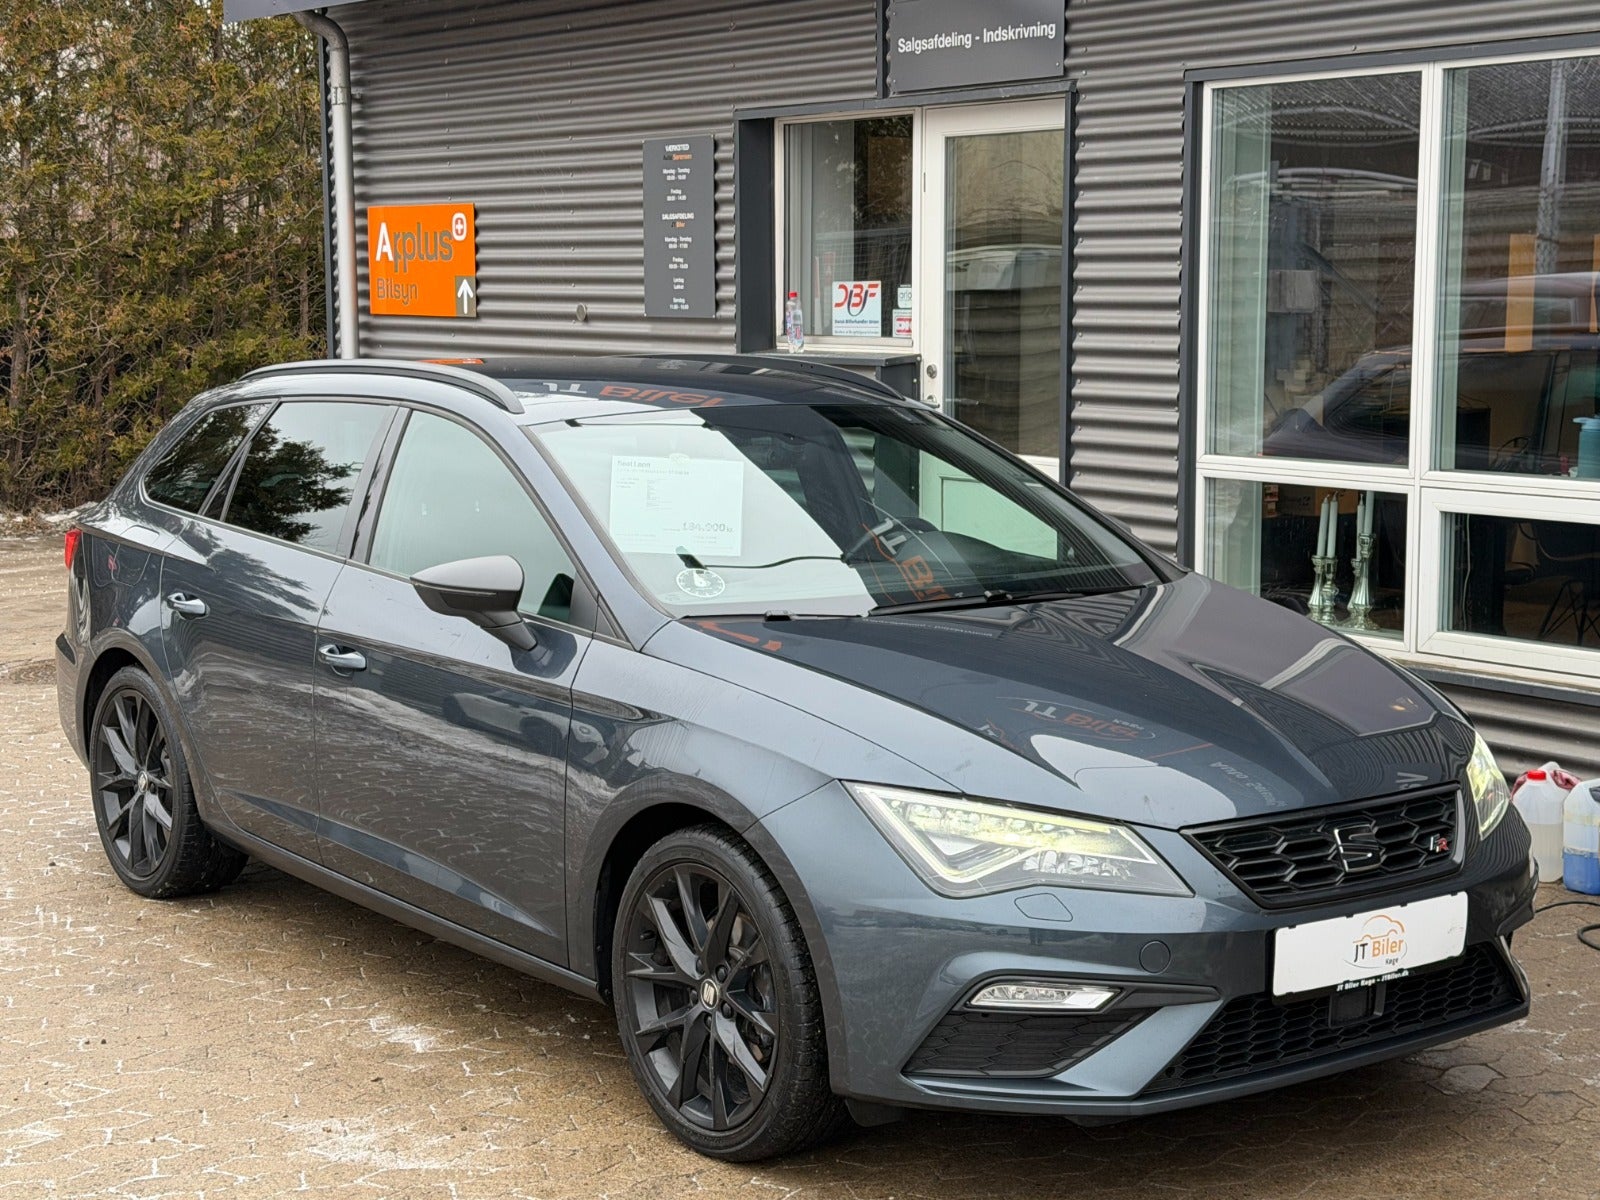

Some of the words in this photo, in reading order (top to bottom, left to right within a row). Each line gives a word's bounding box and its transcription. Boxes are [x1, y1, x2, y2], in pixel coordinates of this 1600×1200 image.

[898, 33, 972, 54] Salgsafdeling
[984, 21, 1056, 43] Indskrivning
[377, 278, 418, 306] Bilsyn
[1354, 943, 1368, 963] JT
[1372, 938, 1404, 957] Biler
[1336, 984, 1344, 992] JT
[1345, 982, 1360, 990] Biler
